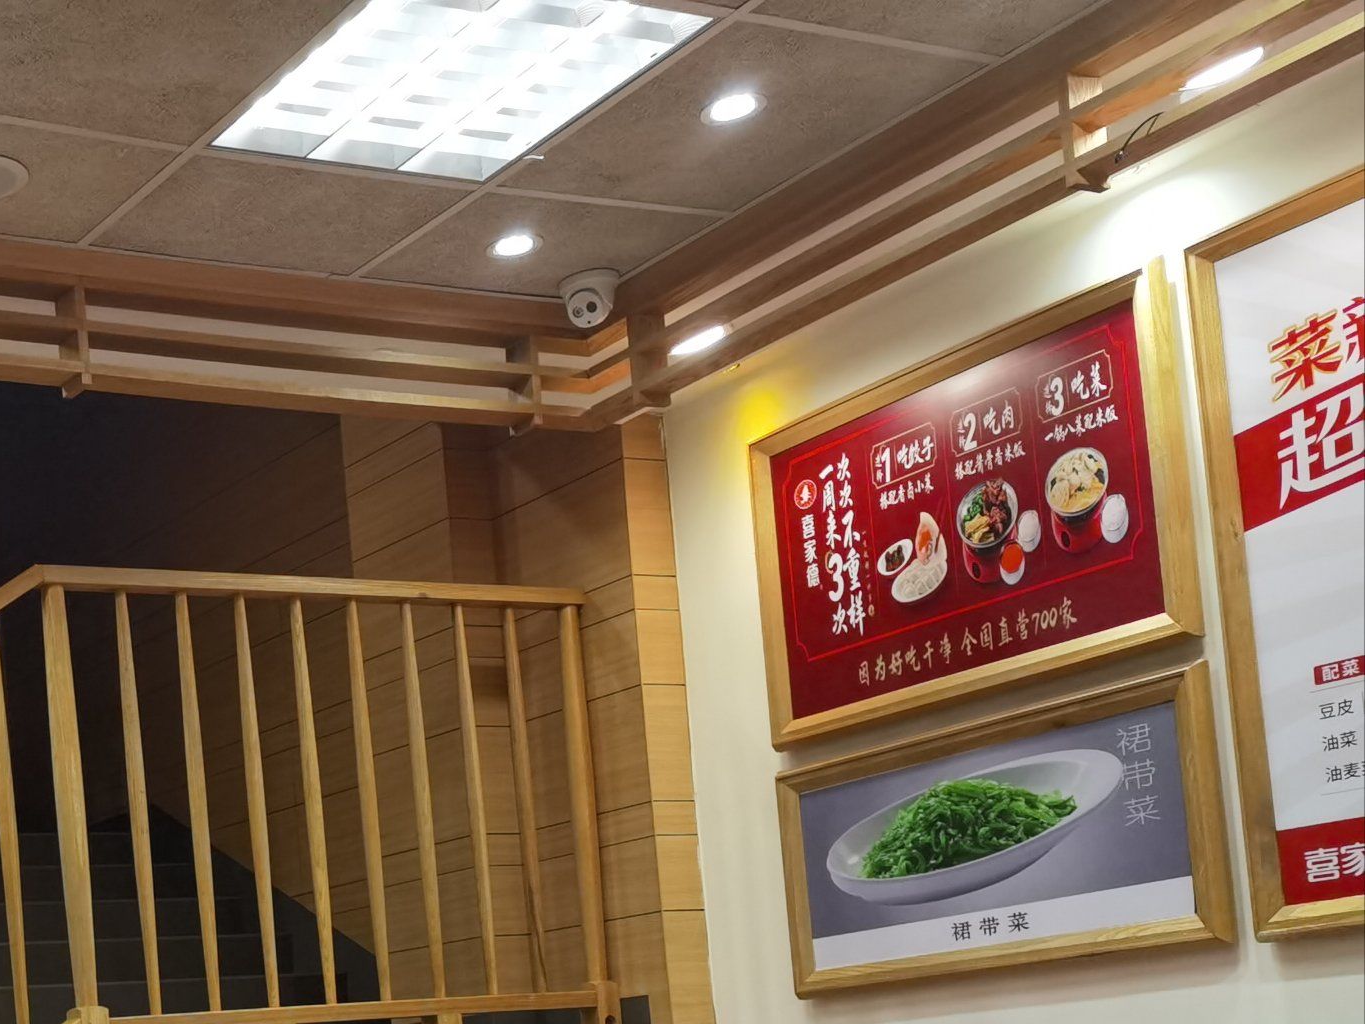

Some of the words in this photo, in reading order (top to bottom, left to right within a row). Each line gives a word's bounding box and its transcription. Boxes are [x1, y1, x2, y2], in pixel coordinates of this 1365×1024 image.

[1071, 361, 1107, 400] 吃菜
[983, 400, 1014, 435] 吃肉
[897, 435, 934, 470] 吃饺子
[1278, 381, 1365, 511] 超
[801, 514, 821, 588] 喜家德
[837, 453, 866, 636] 次次不重样
[858, 632, 952, 687] 因为好吃干净
[961, 597, 1078, 656] 全国直营700家
[1321, 658, 1361, 683] 配菜
[1319, 698, 1354, 720] 豆皮
[1323, 730, 1358, 752] 油菜
[1116, 722, 1160, 827] 裙带菜
[1325, 759, 1365, 784] 油麦
[950, 911, 1030, 941] 裙带菜
